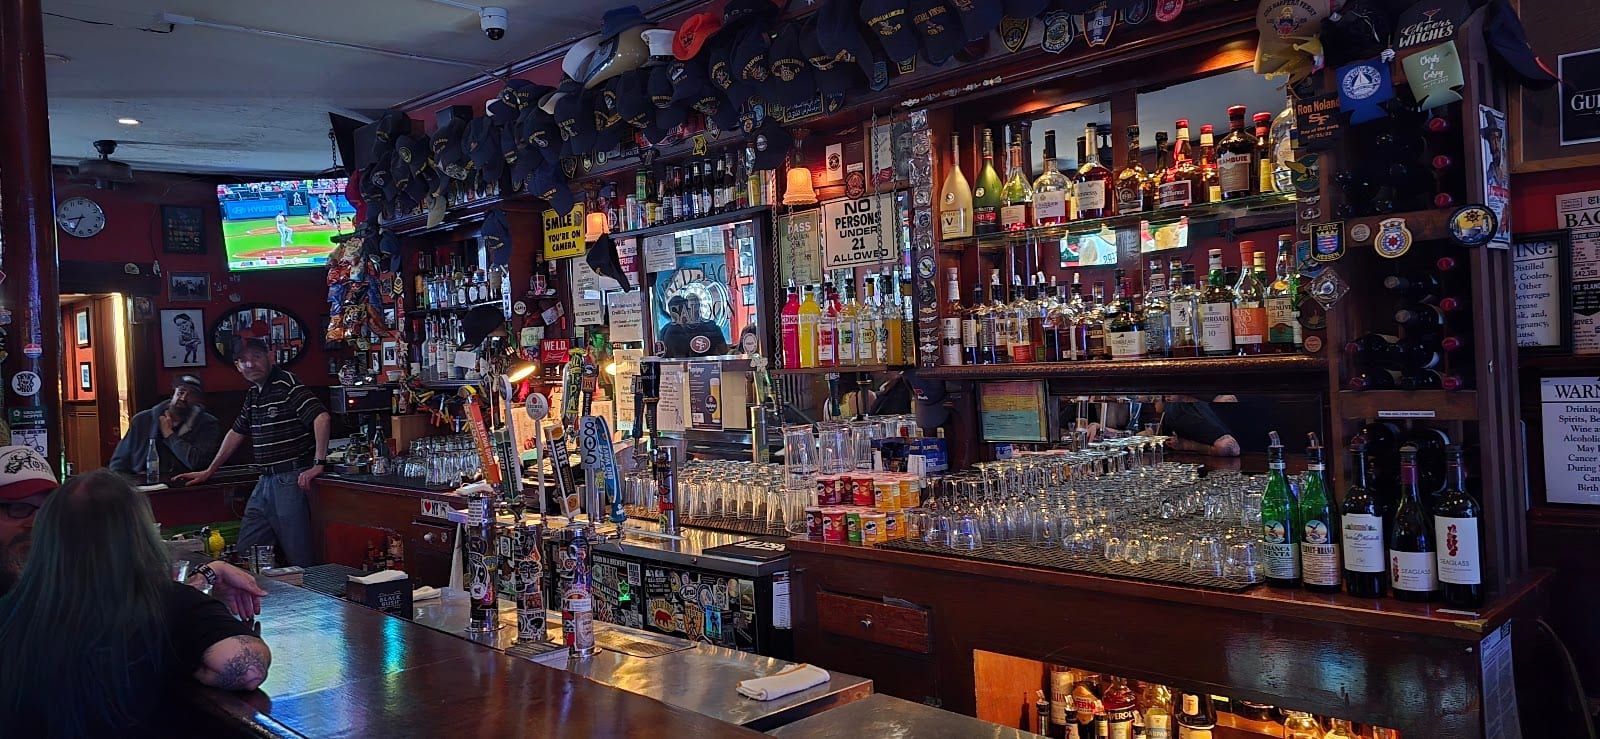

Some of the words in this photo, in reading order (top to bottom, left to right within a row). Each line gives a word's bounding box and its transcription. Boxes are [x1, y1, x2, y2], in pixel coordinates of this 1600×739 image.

[1401, 19, 1452, 36] Cheers
[1399, 25, 1454, 48] WITCHES
[1297, 104, 1312, 115] Ron
[247, 205, 284, 213] HYUNDAI
[844, 198, 871, 215] NO
[545, 215, 572, 231] SMILE
[835, 211, 882, 230] PERSONS
[548, 231, 570, 243] YOU'RE
[571, 229, 581, 238] ON
[839, 226, 880, 239] UNDER
[552, 241, 577, 252] CAMERA
[851, 236, 866, 251] 21
[833, 248, 889, 263] ALLOWED
[1519, 282, 1542, 290] Other
[544, 340, 556, 351] WE
[556, 339, 567, 350] I.D.
[1558, 415, 1587, 424] Spirits,
[1570, 425, 1592, 433] Wine
[583, 421, 597, 465] 805
[555, 440, 569, 467] HEFE
[1577, 445, 1595, 453] May
[1568, 454, 1598, 462] Cancer
[1567, 464, 1597, 473] During
[1577, 484, 1599, 492] Birth
[1440, 558, 1470, 567] SEAGLASS
[379, 594, 401, 603] BLACK
